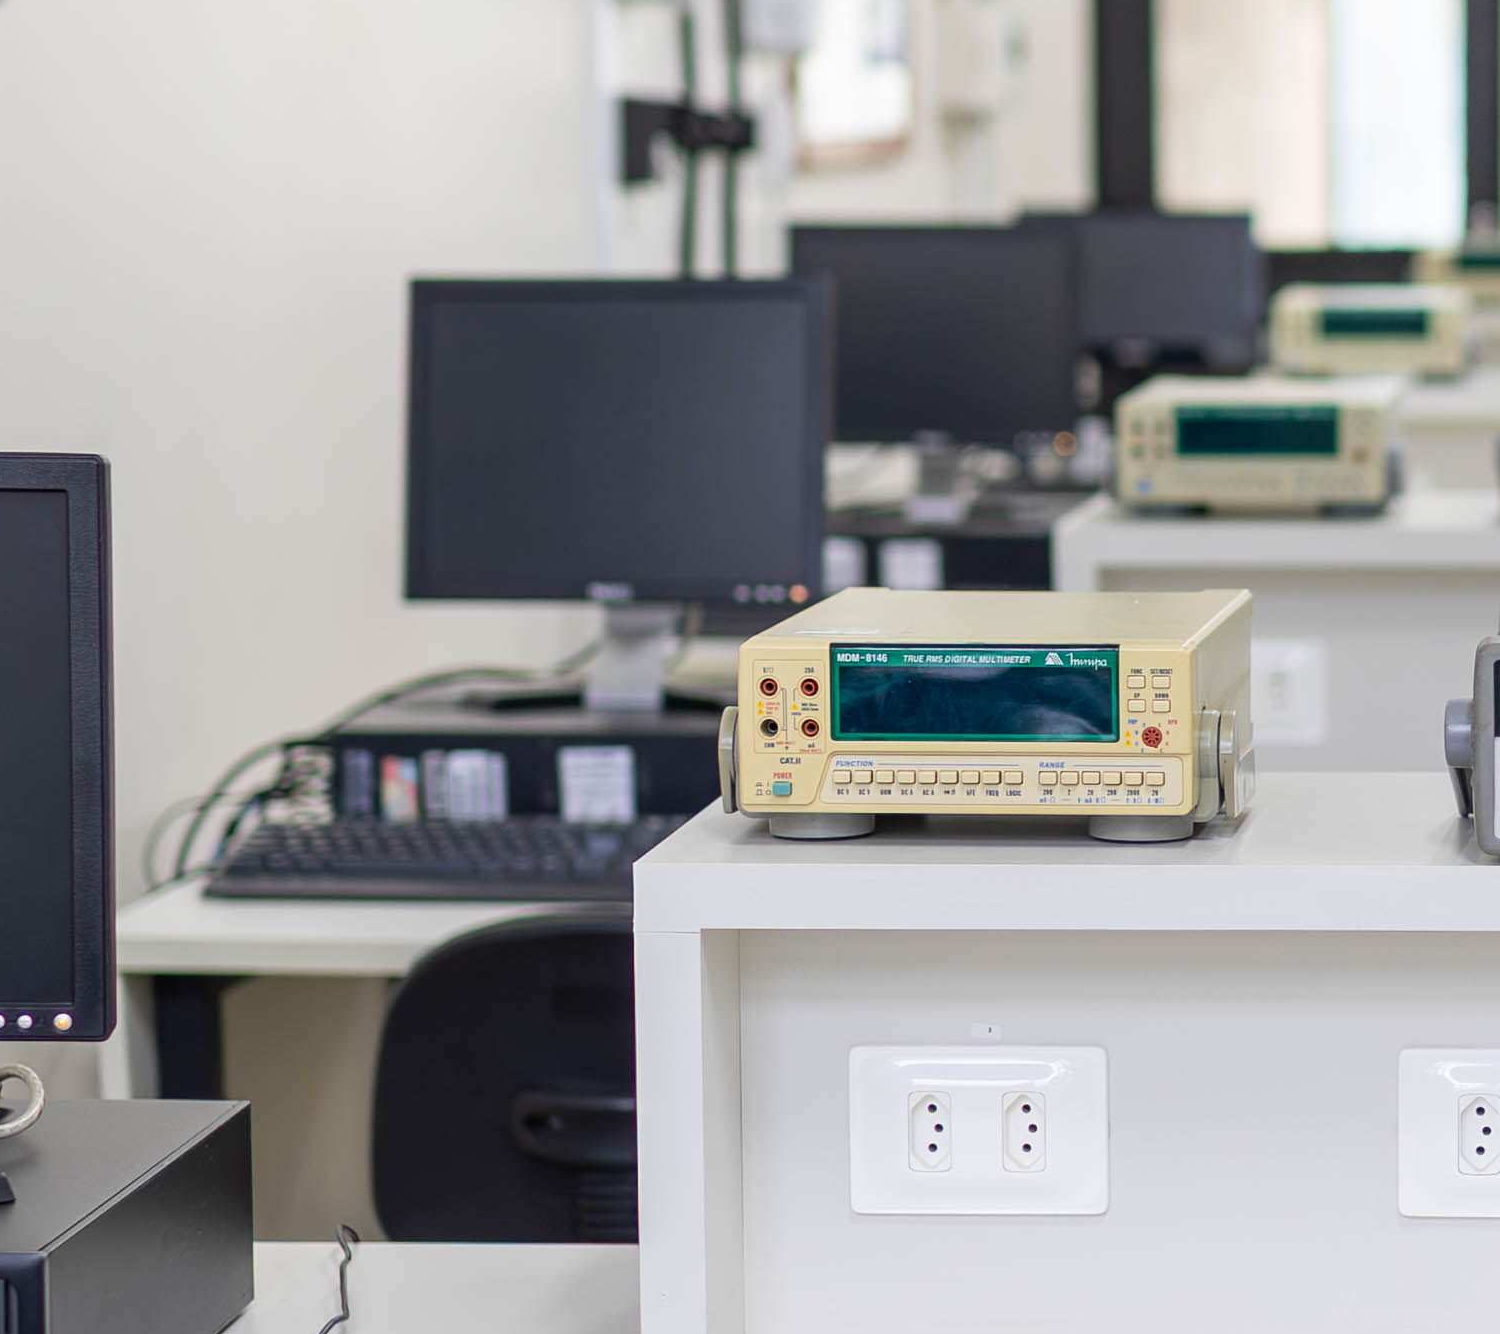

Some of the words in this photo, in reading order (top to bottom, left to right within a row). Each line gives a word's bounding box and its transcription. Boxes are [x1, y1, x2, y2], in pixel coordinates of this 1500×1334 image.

[837, 652, 888, 663] MDM-8146
[903, 655, 924, 664] TRUE
[924, 655, 943, 664] RMS
[943, 655, 972, 664] DIGITAL
[972, 655, 1031, 664] MULTIMETER
[1038, 761, 1065, 769] RANGE
